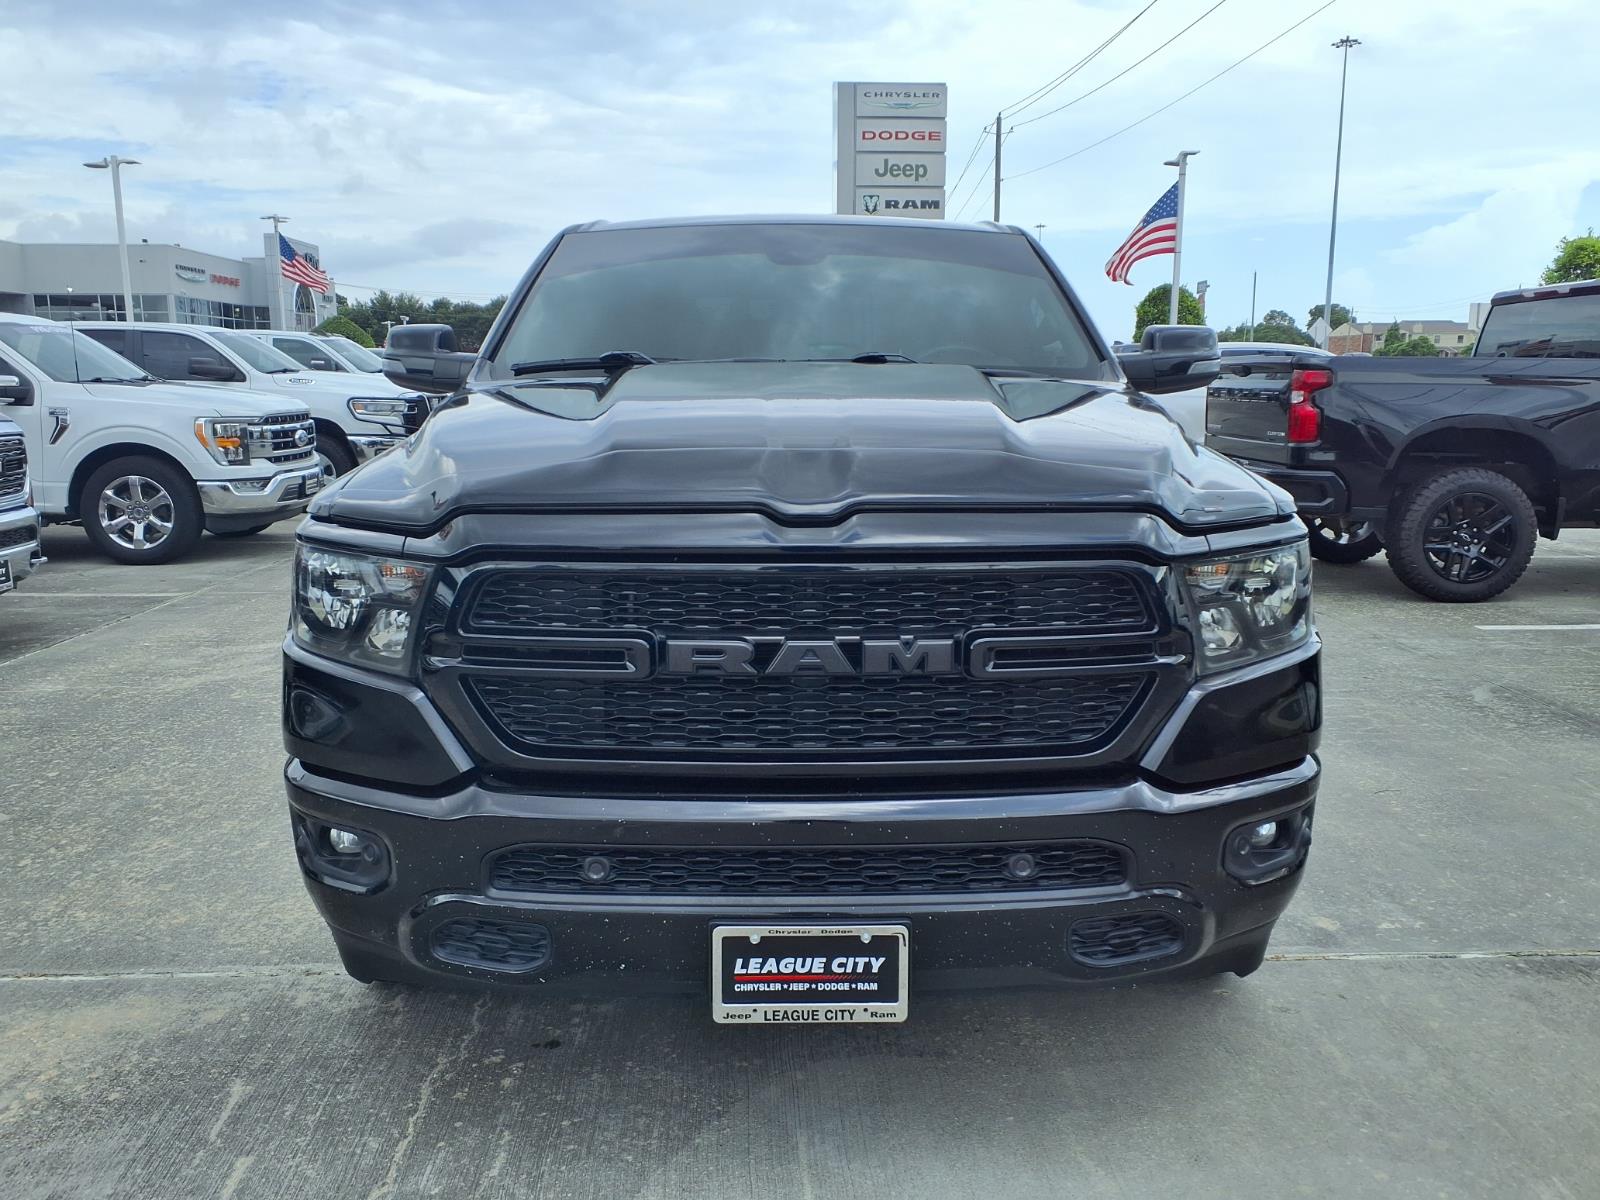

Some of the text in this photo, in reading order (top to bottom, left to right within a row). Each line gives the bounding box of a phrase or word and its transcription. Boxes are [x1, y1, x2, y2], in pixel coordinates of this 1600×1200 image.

[862, 130, 942, 141] DODGE
[874, 158, 928, 182] Jeep
[885, 199, 940, 210] RAM
[666, 636, 955, 674] RAM
[768, 928, 812, 936] Chrysler
[734, 957, 887, 974] LEAGUE CITY
[734, 982, 878, 992] CHRYSLER JEEP DODGE RAM
[722, 1012, 752, 1020] Jeep
[763, 1009, 857, 1022] LEAGUE CITY
[870, 1011, 897, 1019] Ram
